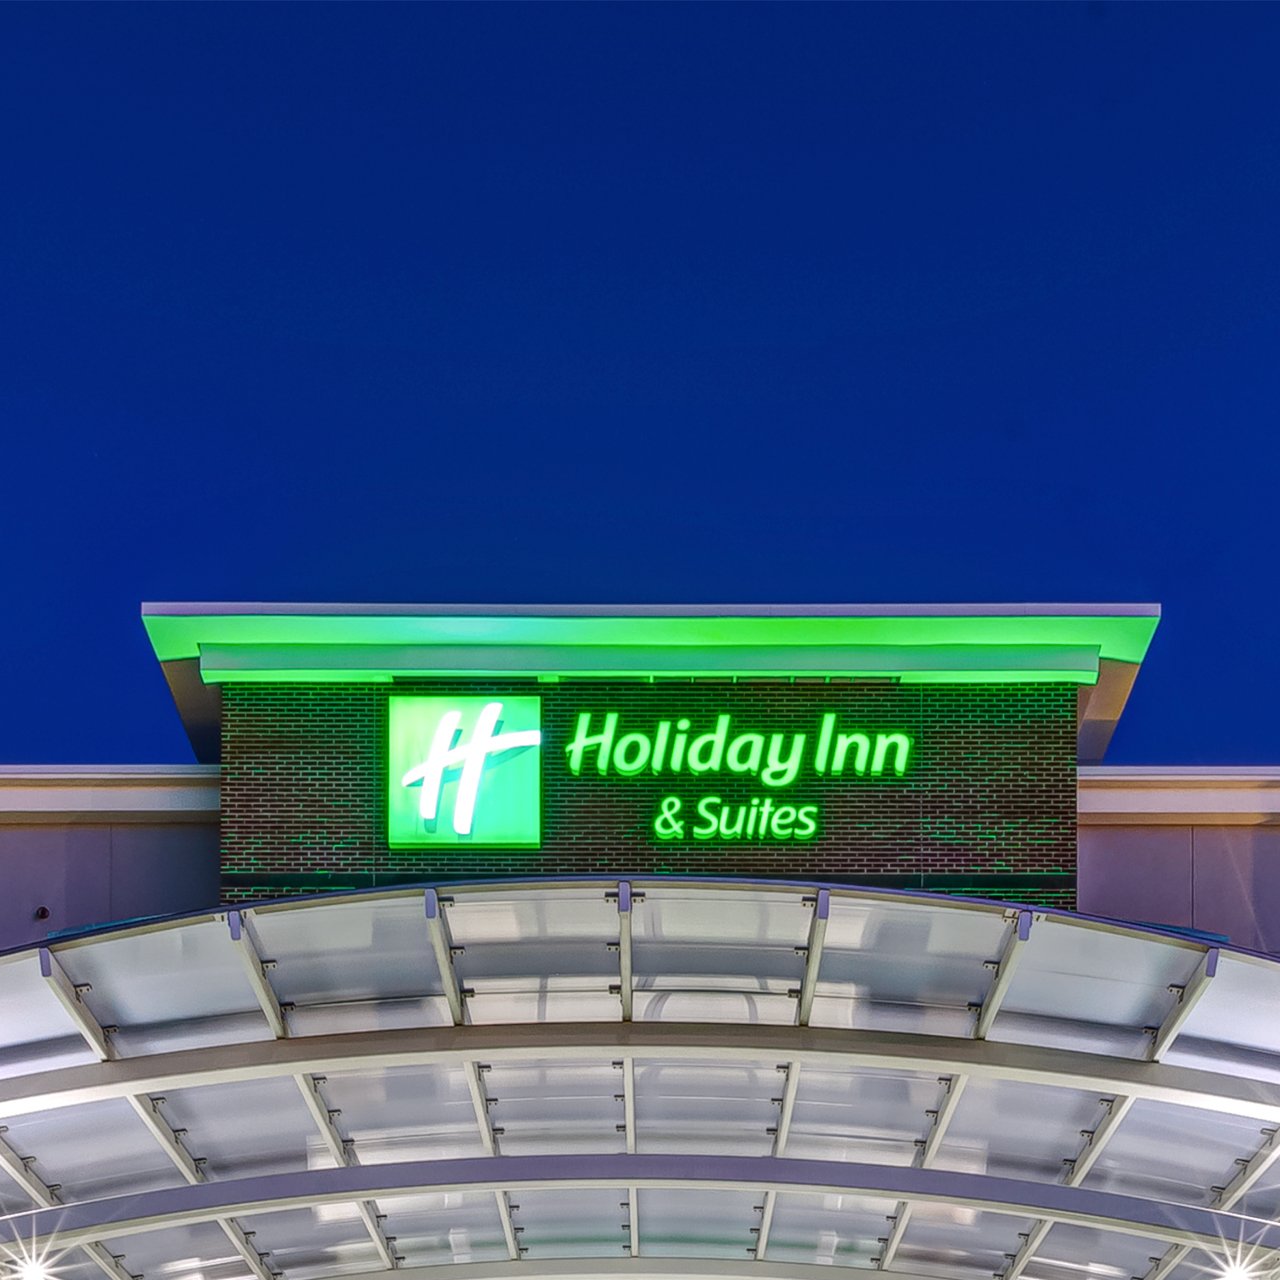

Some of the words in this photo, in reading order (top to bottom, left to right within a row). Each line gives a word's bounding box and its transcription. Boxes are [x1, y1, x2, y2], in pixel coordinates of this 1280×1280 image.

[402, 702, 542, 834] H
[566, 712, 807, 787] Holiday
[816, 712, 911, 777] Inn
[655, 797, 685, 838] &
[692, 797, 818, 838] Suites
